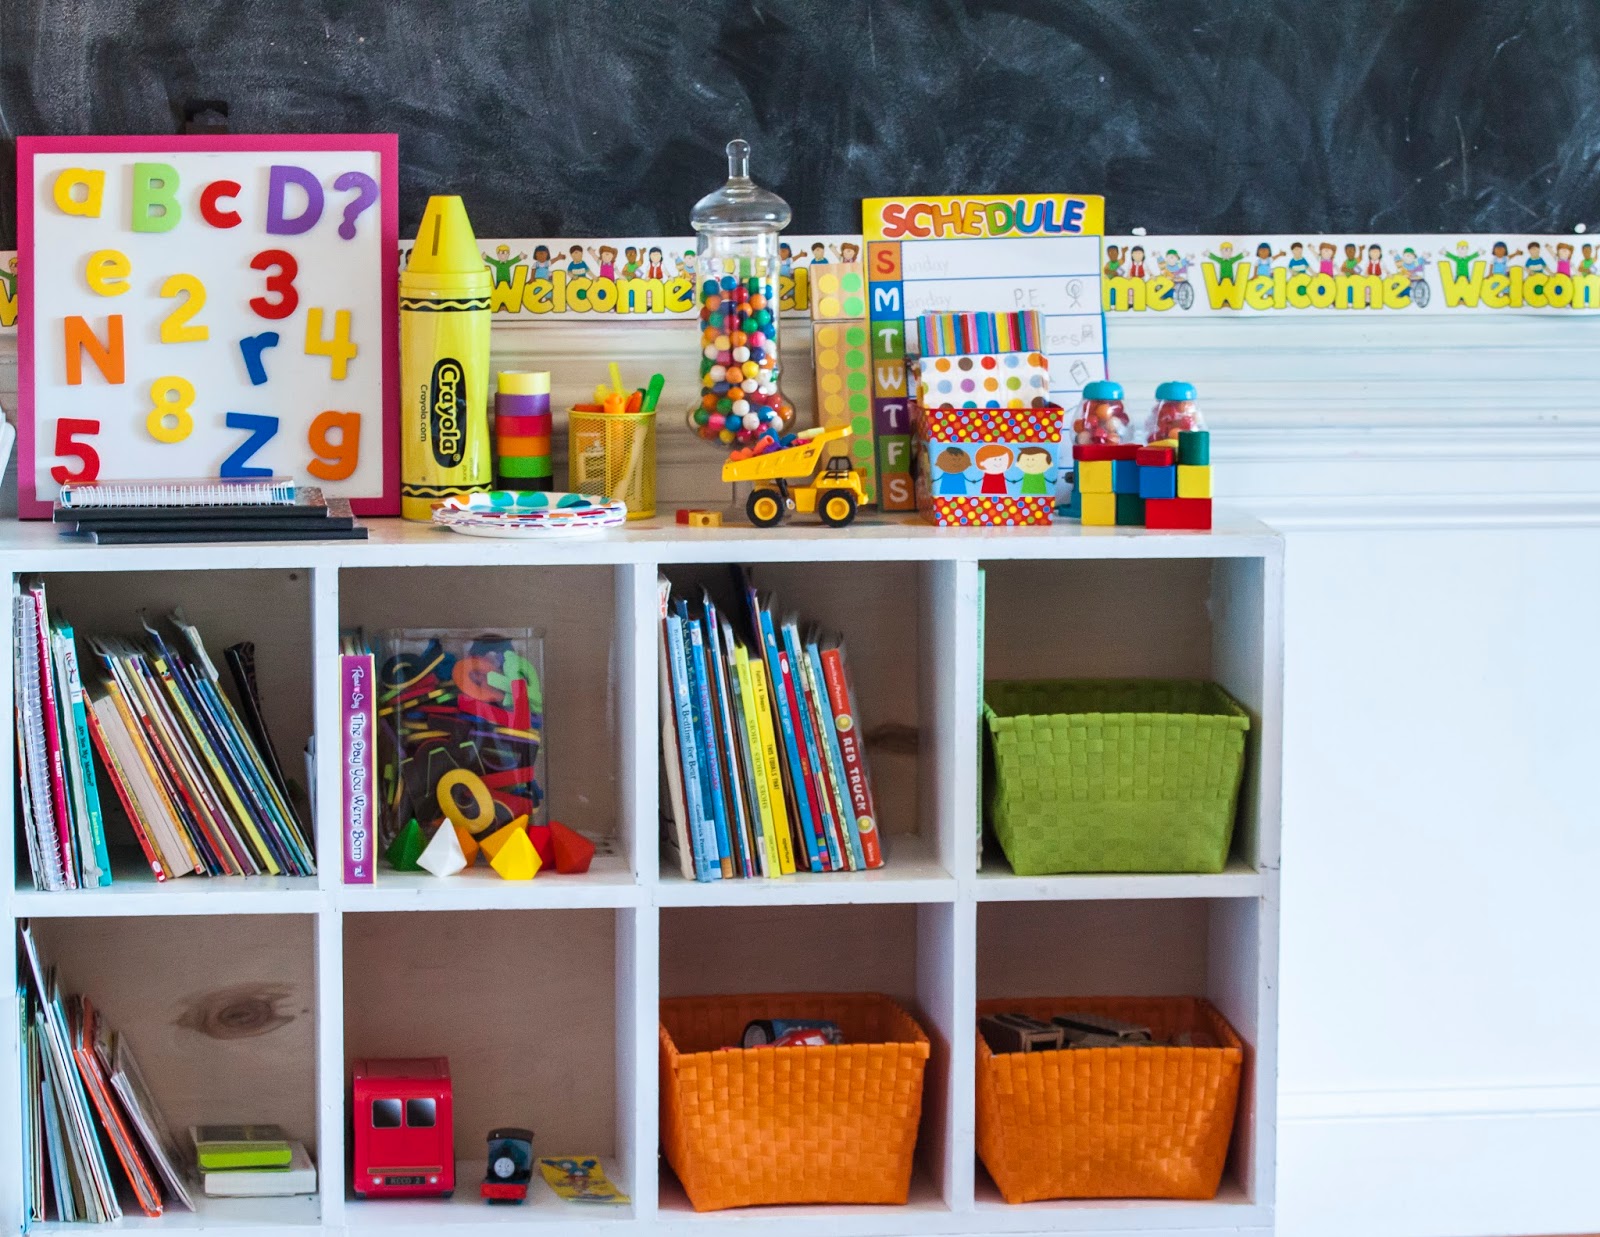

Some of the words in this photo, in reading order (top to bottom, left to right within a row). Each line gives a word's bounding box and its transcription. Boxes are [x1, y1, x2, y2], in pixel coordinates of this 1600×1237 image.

[53, 168, 105, 218] a
[132, 162, 182, 232] B
[266, 165, 325, 235] D
[881, 200, 1085, 237] SCHEDULE
[85, 249, 132, 297] e
[877, 250, 895, 274] S
[249, 249, 299, 320] 3
[487, 265, 694, 314] Welcome
[1013, 287, 1046, 309] P.E.
[1200, 262, 1412, 310] Welcome
[1437, 261, 1600, 310] Welcom
[160, 273, 209, 344] 2
[875, 287, 899, 312] M
[64, 314, 125, 385] N
[304, 307, 357, 380] 4
[877, 328, 899, 353] T
[239, 331, 280, 386] r
[878, 366, 902, 389] W
[146, 376, 196, 444] 8
[419, 384, 428, 442] Crayola.com
[435, 363, 461, 455] Crayola
[882, 403, 903, 428] T
[50, 417, 100, 484] 5
[306, 411, 361, 481] g
[888, 441, 905, 465] F
[889, 479, 908, 502] S
[171, 686, 186, 707] Winnie
[183, 706, 191, 716] the
[187, 714, 199, 731] Pooh
[195, 729, 205, 742] and
[680, 701, 688, 709] A
[351, 714, 363, 736] The
[681, 709, 693, 743] Bedtime
[748, 719, 757, 743] SHOES
[80, 749, 88, 760] My
[350, 740, 364, 763] Day
[686, 745, 695, 759] for
[766, 743, 774, 755] THIS
[842, 736, 857, 763] RED
[83, 760, 94, 787] Mother?
[687, 760, 697, 780] Bear
[753, 751, 763, 777] SHOES
[768, 756, 777, 776] EQUALS
[350, 767, 364, 790] You
[848, 765, 866, 811] TRUCK
[352, 795, 364, 825] Were
[758, 784, 768, 809] SHOES
[90, 810, 102, 845] Eastman
[352, 829, 364, 860] Born
[781, 837, 791, 863] aperture
[865, 841, 875, 862] Viking
